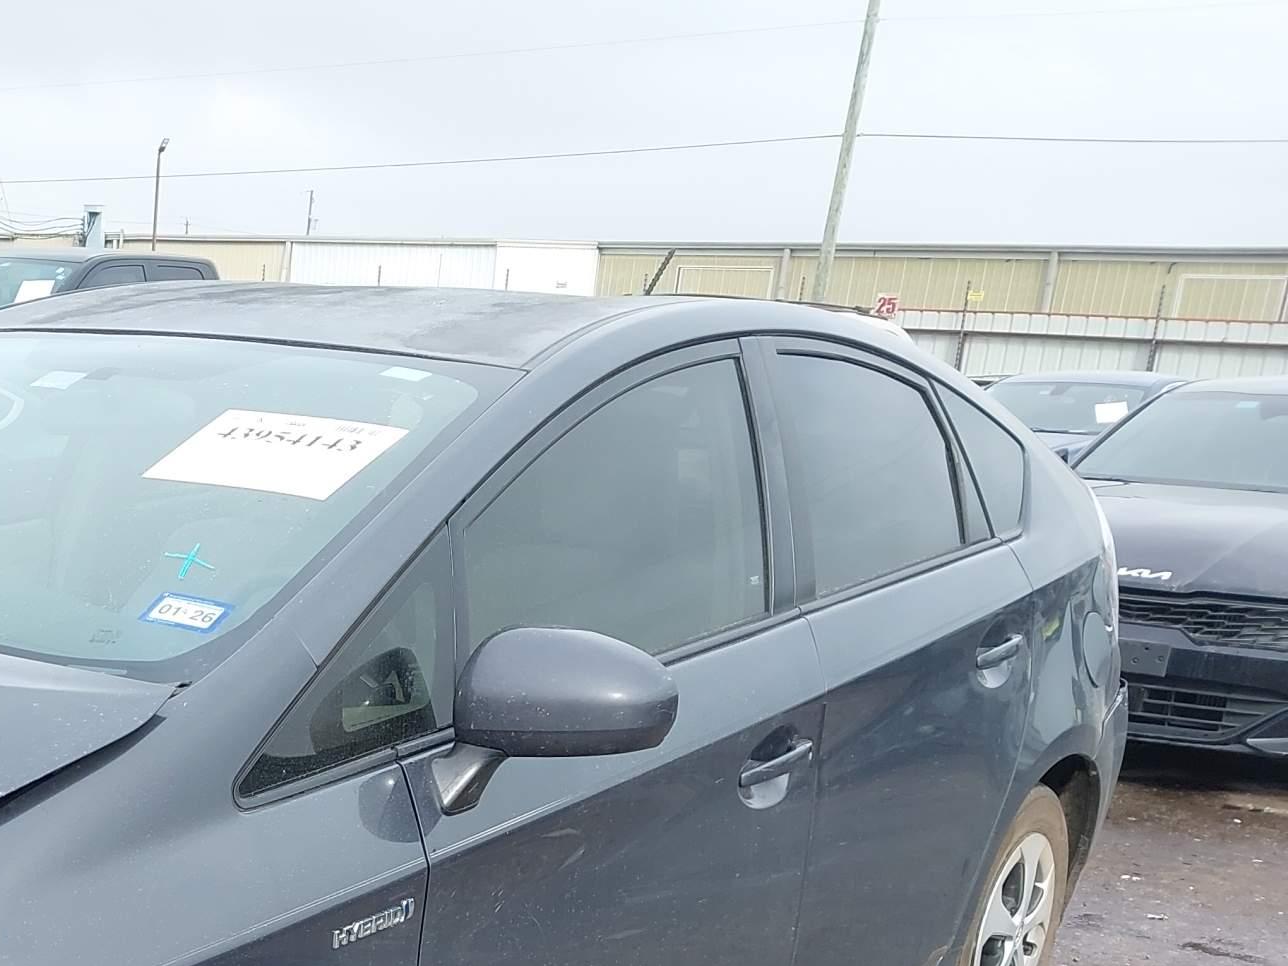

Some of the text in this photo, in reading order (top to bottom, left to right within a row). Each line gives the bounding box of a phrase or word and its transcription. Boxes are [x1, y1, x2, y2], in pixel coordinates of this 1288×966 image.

[875, 297, 899, 314] 25
[158, 603, 217, 623] 01 26
[331, 897, 415, 950] HYBRID
